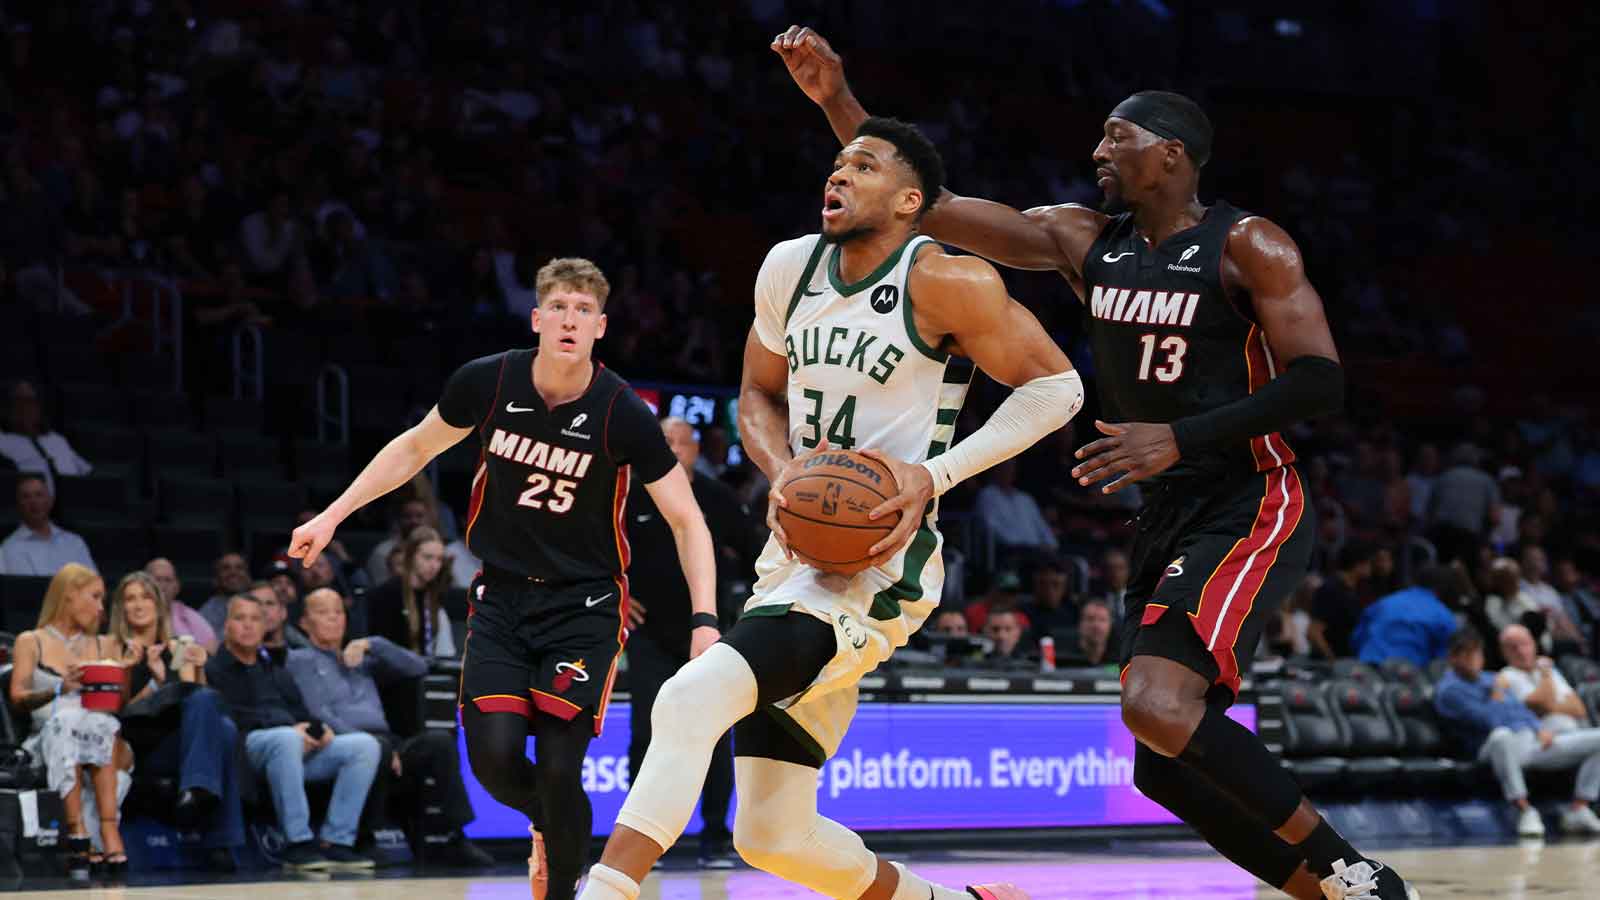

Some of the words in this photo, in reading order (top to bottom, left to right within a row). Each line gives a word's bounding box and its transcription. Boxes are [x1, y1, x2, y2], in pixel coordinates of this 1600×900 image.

[1167, 263, 1201, 273] Robinhood
[1090, 285, 1201, 327] MIAMI
[785, 327, 905, 385] BUCKS
[1137, 333, 1188, 384] 13
[802, 388, 857, 449] 34
[488, 428, 594, 479] MIAMI
[517, 472, 578, 514] 25
[829, 748, 982, 798] platform.
